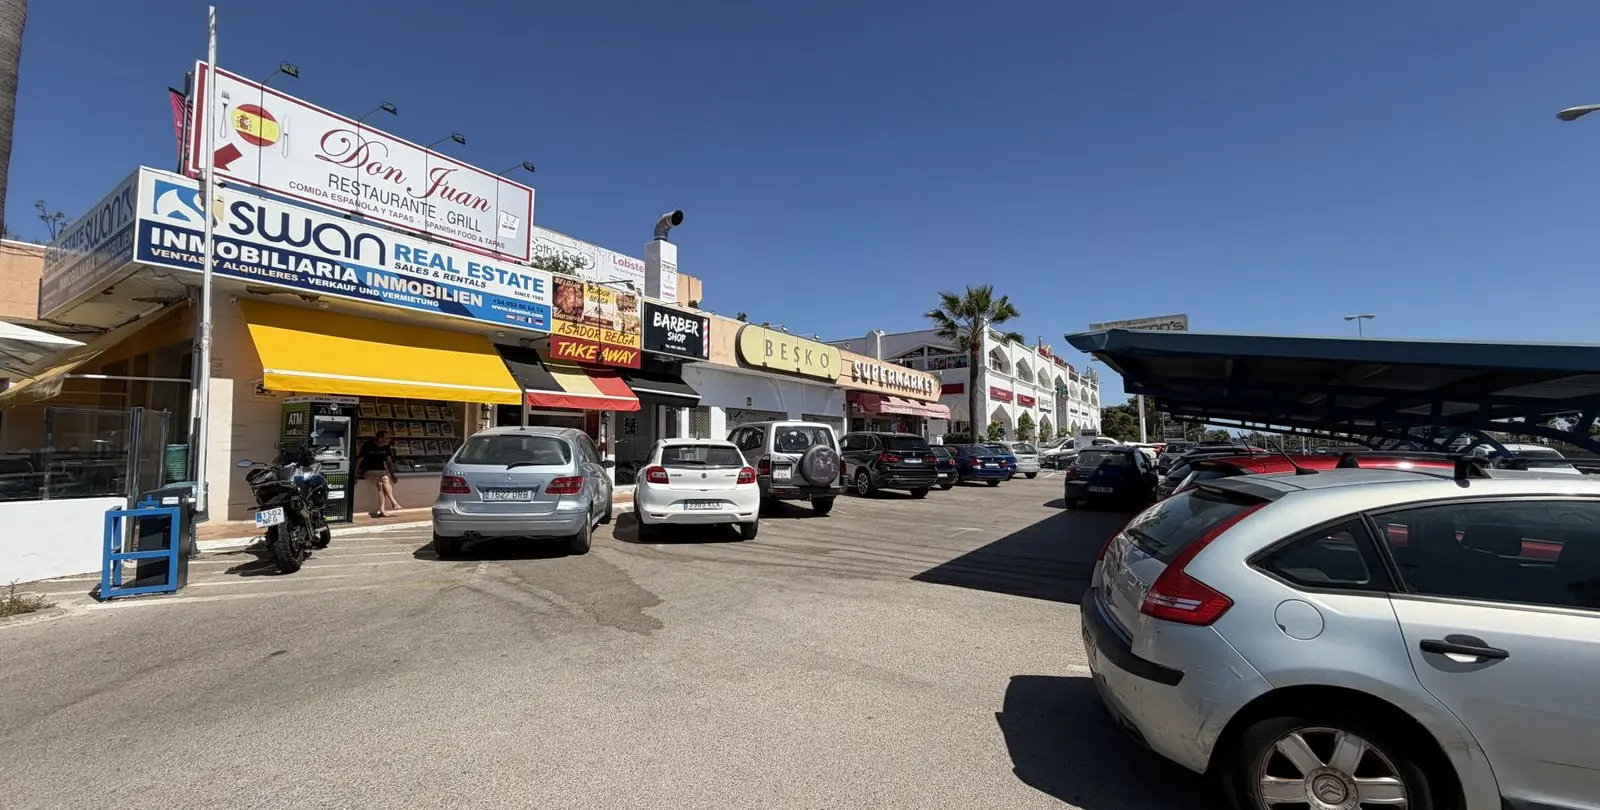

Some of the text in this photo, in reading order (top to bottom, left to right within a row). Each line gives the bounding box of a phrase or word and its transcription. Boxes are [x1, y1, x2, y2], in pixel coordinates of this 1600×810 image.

[315, 128, 492, 213] Don Juan
[289, 181, 329, 200] COMIDA
[381, 206, 388, 216] Y
[388, 208, 415, 224] TAPAS
[425, 219, 457, 237] SPANISH
[457, 230, 478, 242] FOOD
[485, 237, 506, 250] TAPAS
[328, 173, 436, 219] RESTAURANTE
[447, 211, 482, 233] GRILL
[151, 226, 359, 285] INMOBILIARIA
[366, 271, 483, 307] INMOBILIEN
[151, 246, 205, 265] VENTAS
[210, 258, 219, 267] Y
[223, 261, 298, 281] ALQUILERES
[308, 276, 356, 292] VERKAUF
[359, 287, 380, 297] UND
[382, 290, 439, 307] VERMIETUNG
[394, 243, 460, 274] REAL
[467, 261, 545, 294] ESTATE
[394, 262, 487, 288] SALES & RENTALS
[613, 254, 645, 273] Lobste
[514, 290, 531, 298] SINCE
[558, 322, 635, 346] ASADOR BELGA
[653, 311, 699, 337] BARBER
[667, 331, 686, 344] SHOP
[557, 341, 638, 365] TAKE AWAY
[765, 339, 829, 368] BESKO
[854, 359, 936, 393] SUPERMARKET
[288, 412, 303, 425] ATM
[319, 406, 343, 415] ATM
[262, 508, 282, 518] 1502
[262, 516, 278, 525] NFG
